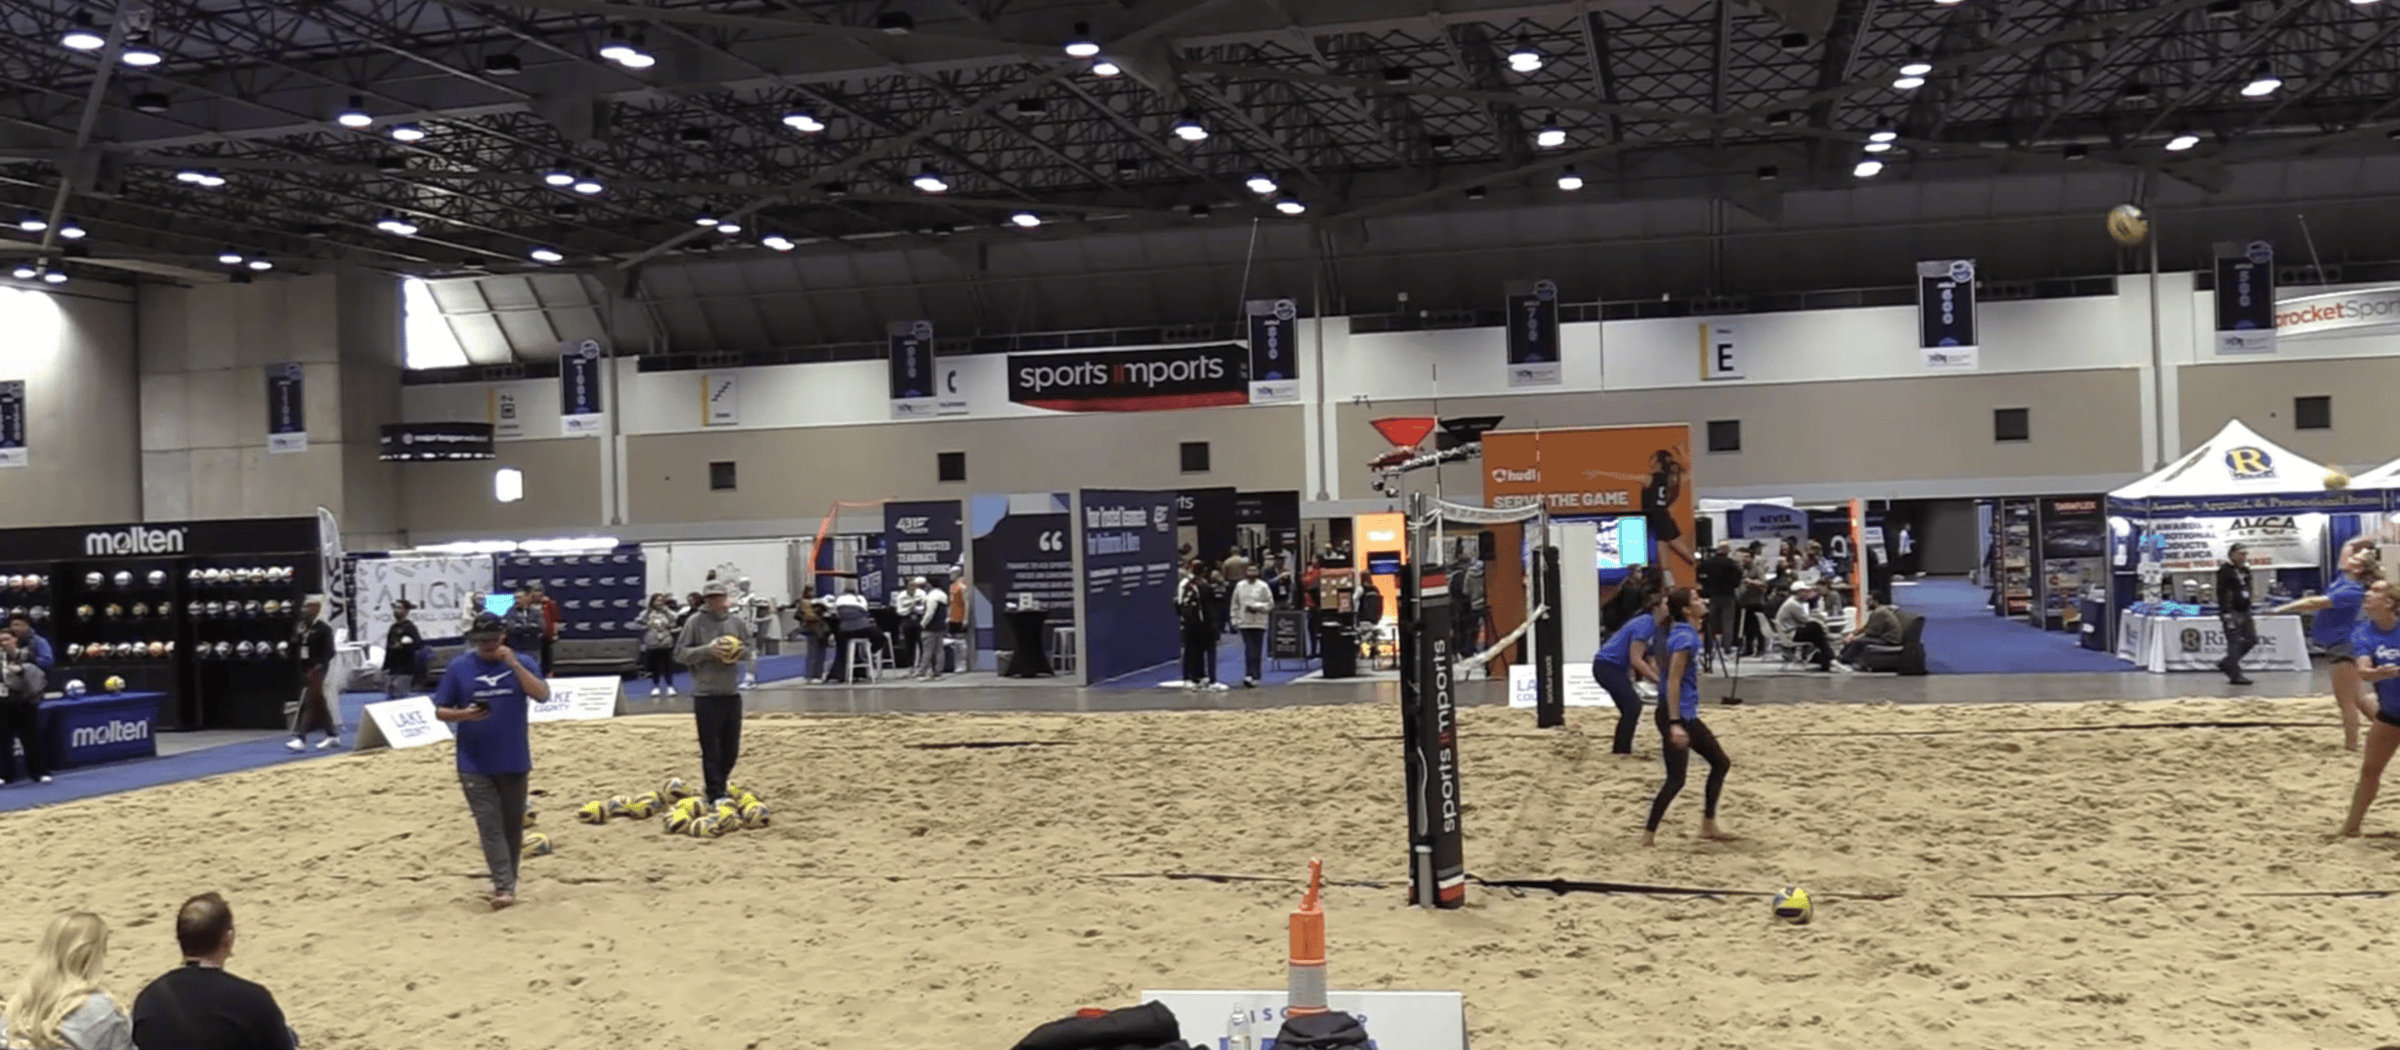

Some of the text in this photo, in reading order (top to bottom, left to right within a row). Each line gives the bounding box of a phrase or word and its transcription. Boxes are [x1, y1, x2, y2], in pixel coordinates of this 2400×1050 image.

[1717, 344, 1735, 371] E
[1020, 362, 1108, 392] sports
[1175, 495, 1194, 510] rts
[1550, 493, 1578, 506] THE
[1583, 491, 1629, 506] GAME
[86, 527, 184, 555] molten
[390, 711, 427, 728] LAKE
[72, 720, 148, 747] molten
[1438, 747, 1455, 833] sports
